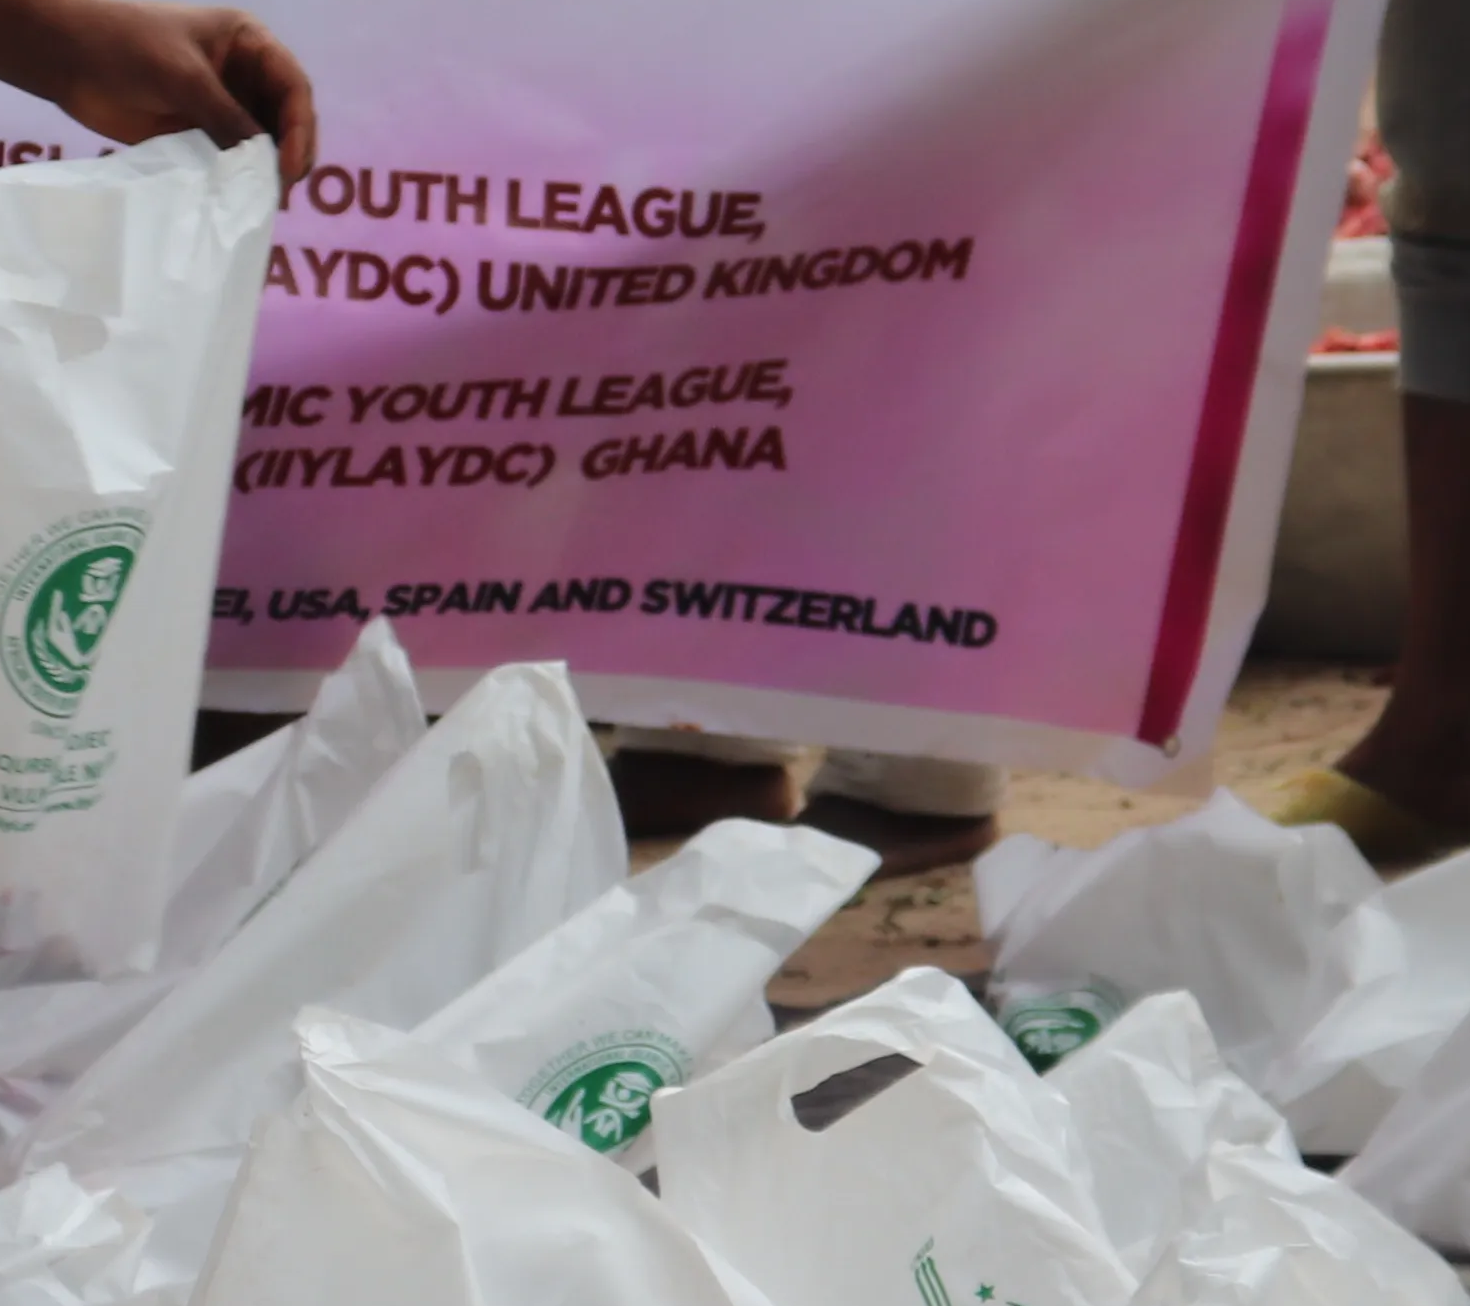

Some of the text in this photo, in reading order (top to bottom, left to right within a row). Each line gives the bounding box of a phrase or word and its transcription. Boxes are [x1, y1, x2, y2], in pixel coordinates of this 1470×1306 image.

[506, 179, 767, 243] LEAGUE,
[479, 260, 696, 311] UNITED
[705, 238, 974, 299] KINGDOM
[347, 377, 551, 425] YOUTH
[556, 360, 793, 417] LEAGUE,
[582, 426, 787, 483] GHANA
[268, 586, 371, 624] USA,
[379, 580, 523, 618] SPAIN
[527, 577, 632, 615] AND
[642, 579, 998, 648] SWITZERLAND
